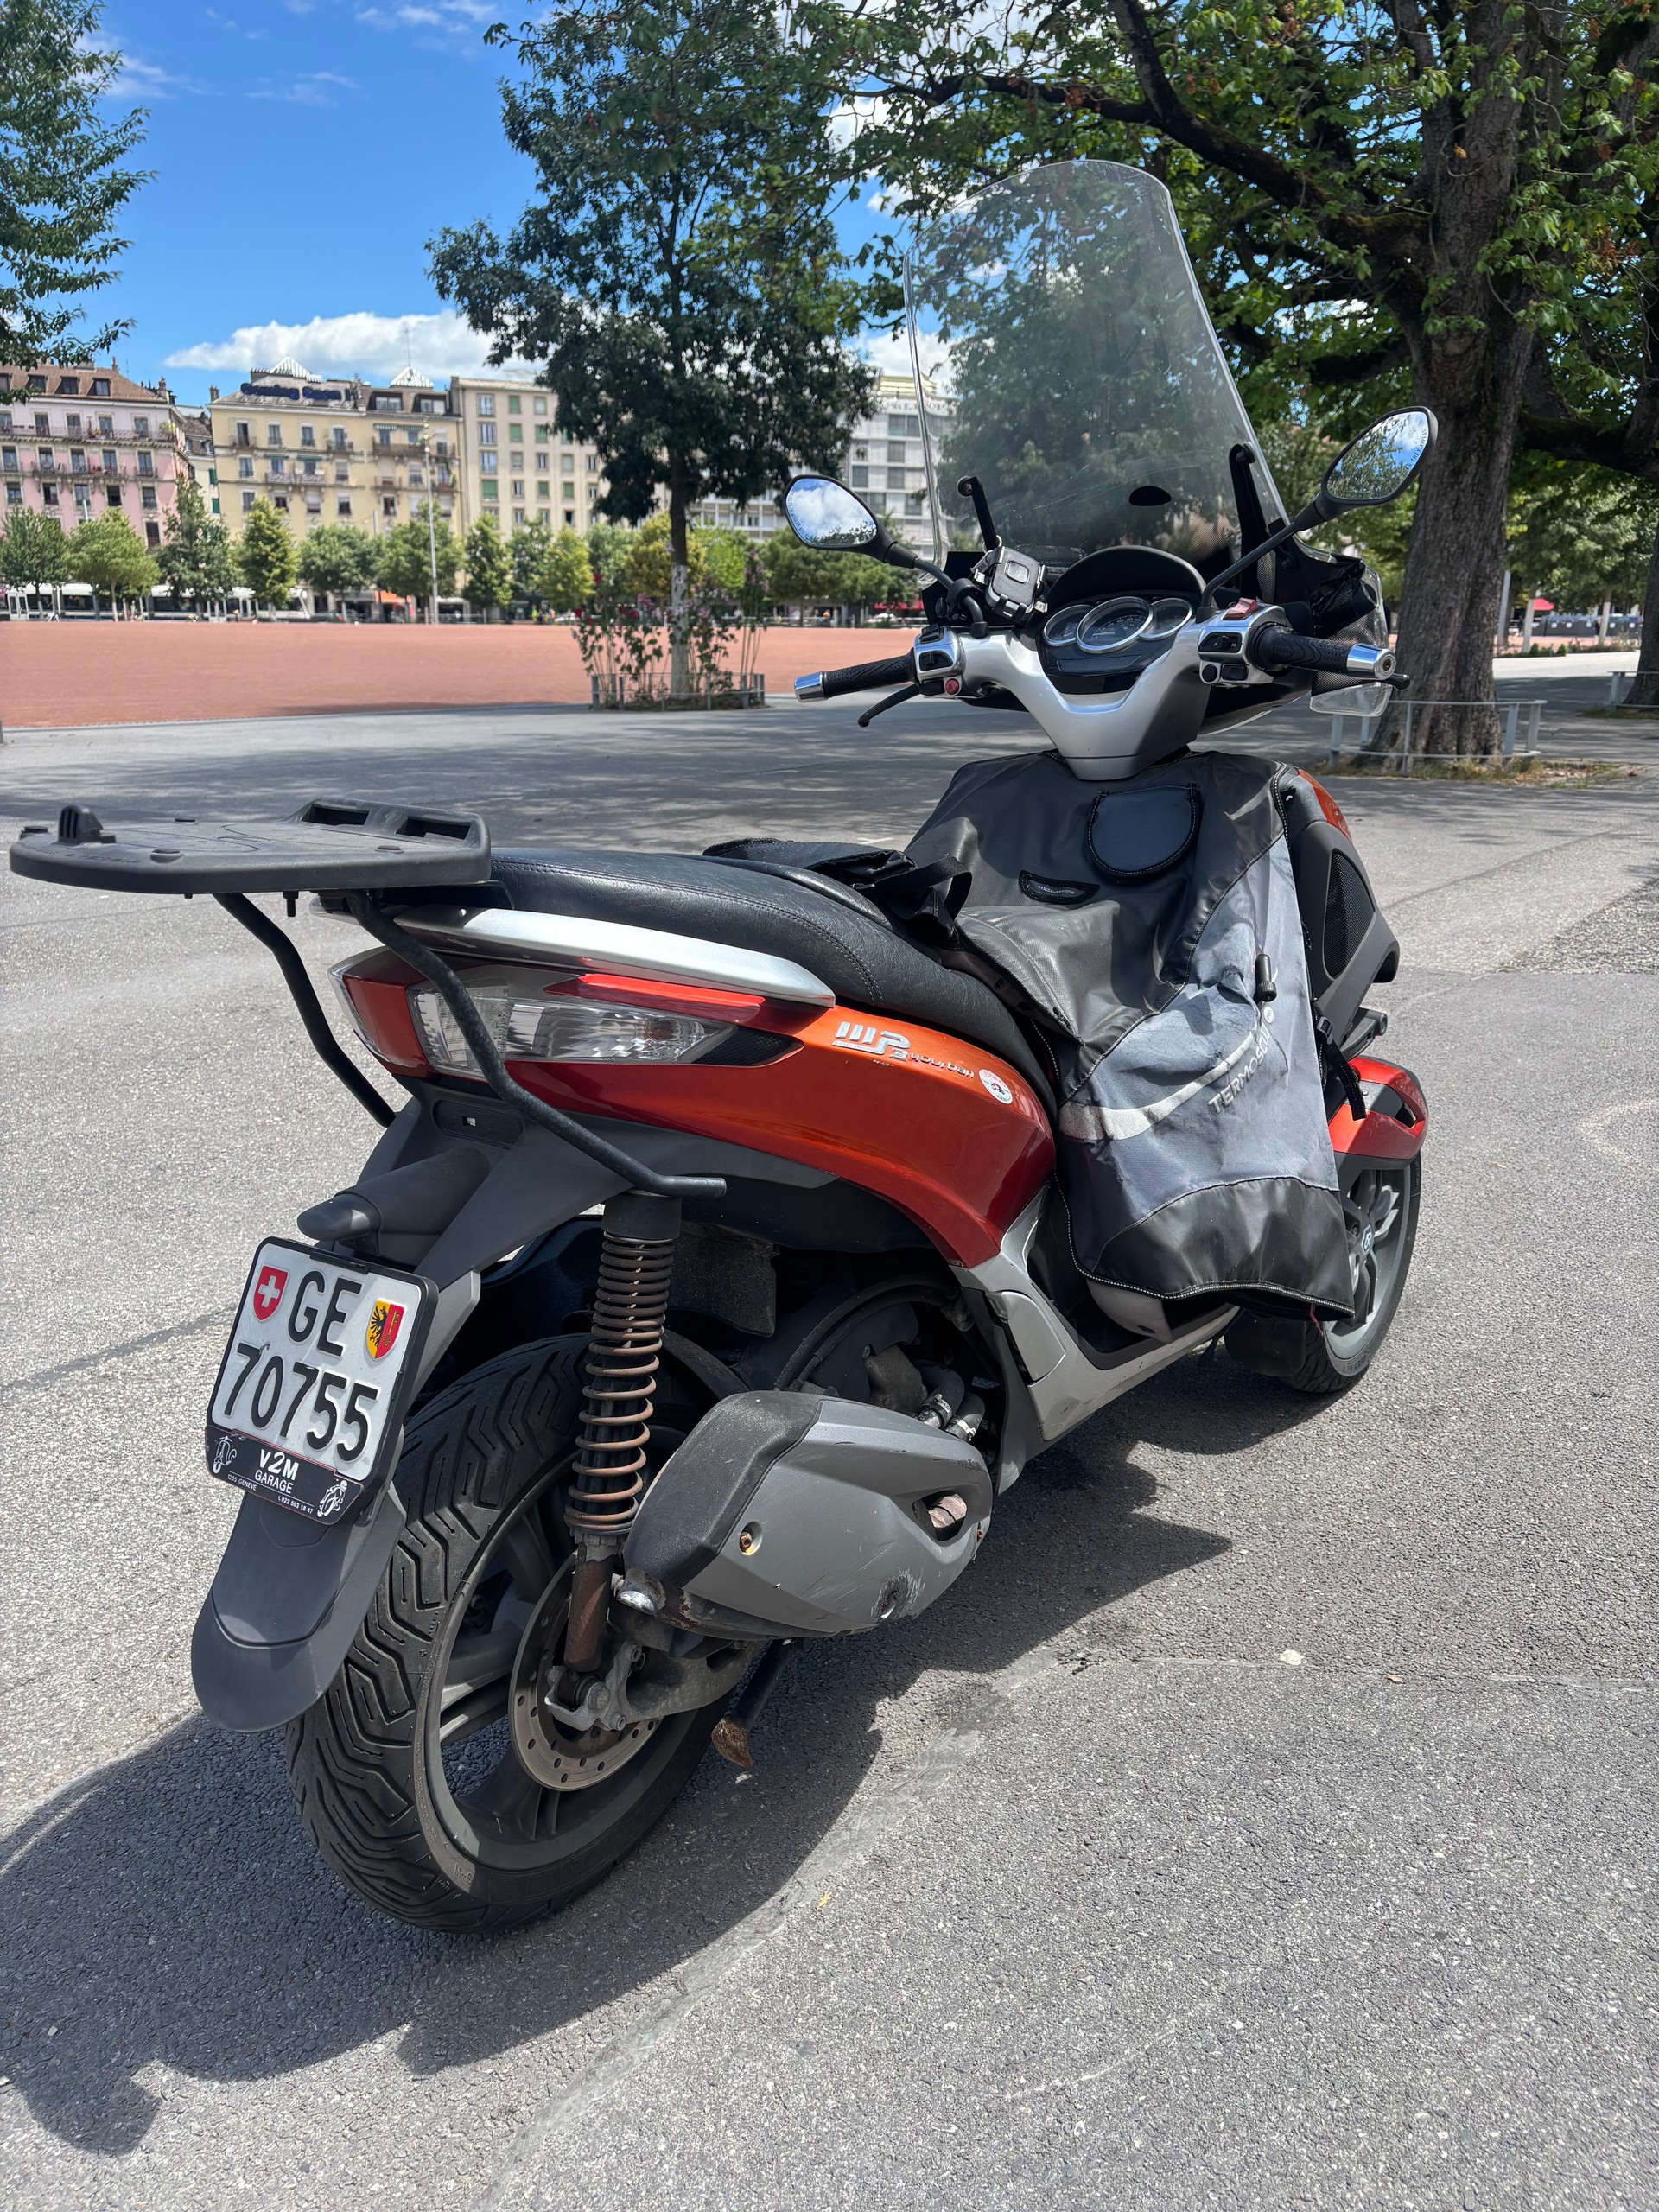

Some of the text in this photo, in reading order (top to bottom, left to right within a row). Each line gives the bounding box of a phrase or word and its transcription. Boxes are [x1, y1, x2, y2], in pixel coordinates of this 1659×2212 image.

[288, 1270, 362, 1357] GE
[224, 1342, 379, 1463] 70755
[259, 1448, 299, 1481] V2M
[254, 1469, 294, 1494] GARAGE
[281, 1496, 290, 1505] 022
